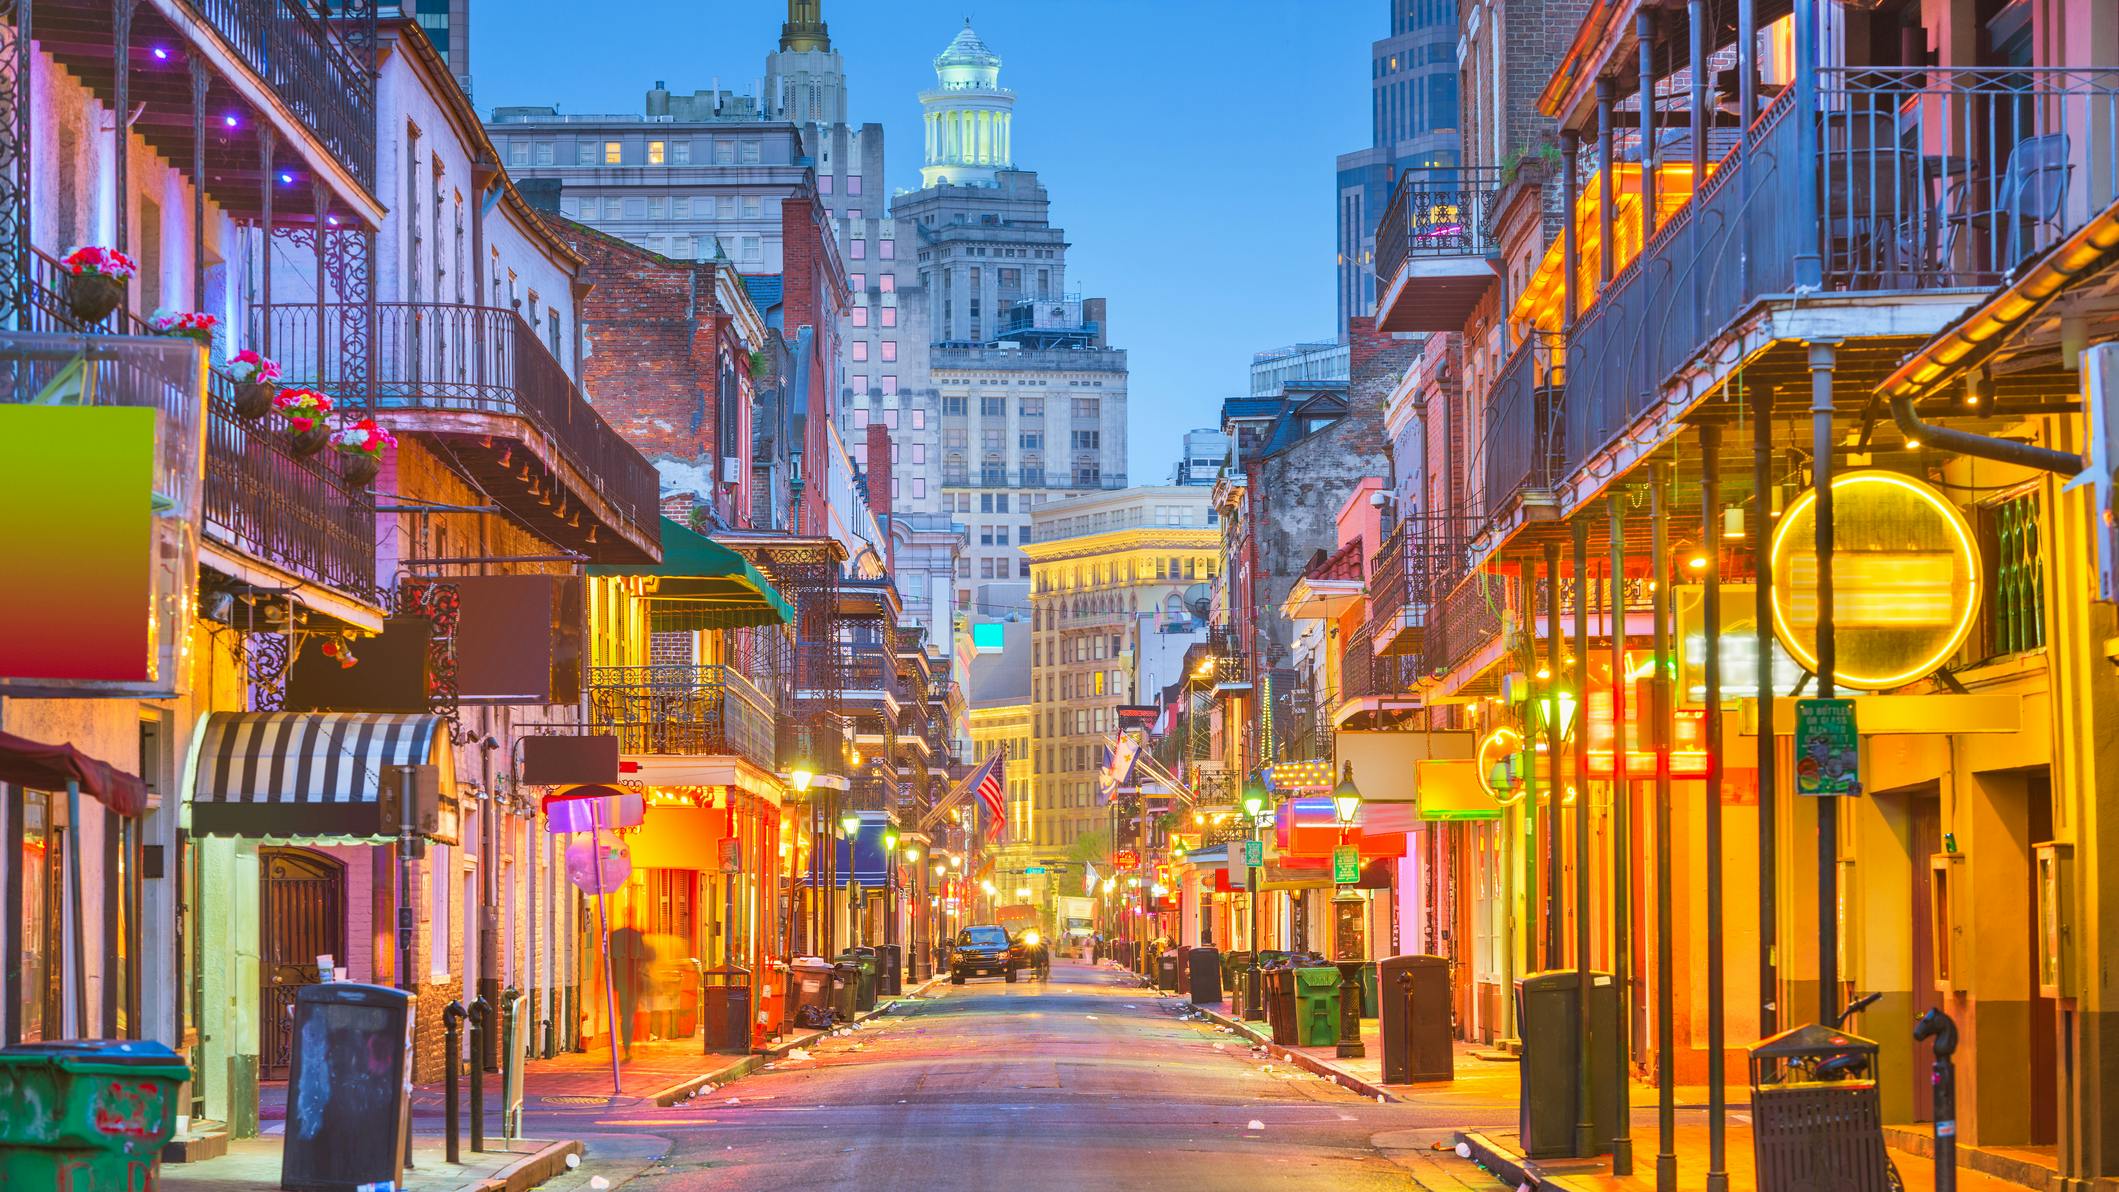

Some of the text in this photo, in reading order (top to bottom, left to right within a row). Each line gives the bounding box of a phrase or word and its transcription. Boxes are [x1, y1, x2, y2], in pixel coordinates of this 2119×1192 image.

[1802, 707, 1851, 715] NO BOTTLES
[1806, 716, 1847, 724] OR GLASS
[1809, 726, 1846, 734] ALLD
